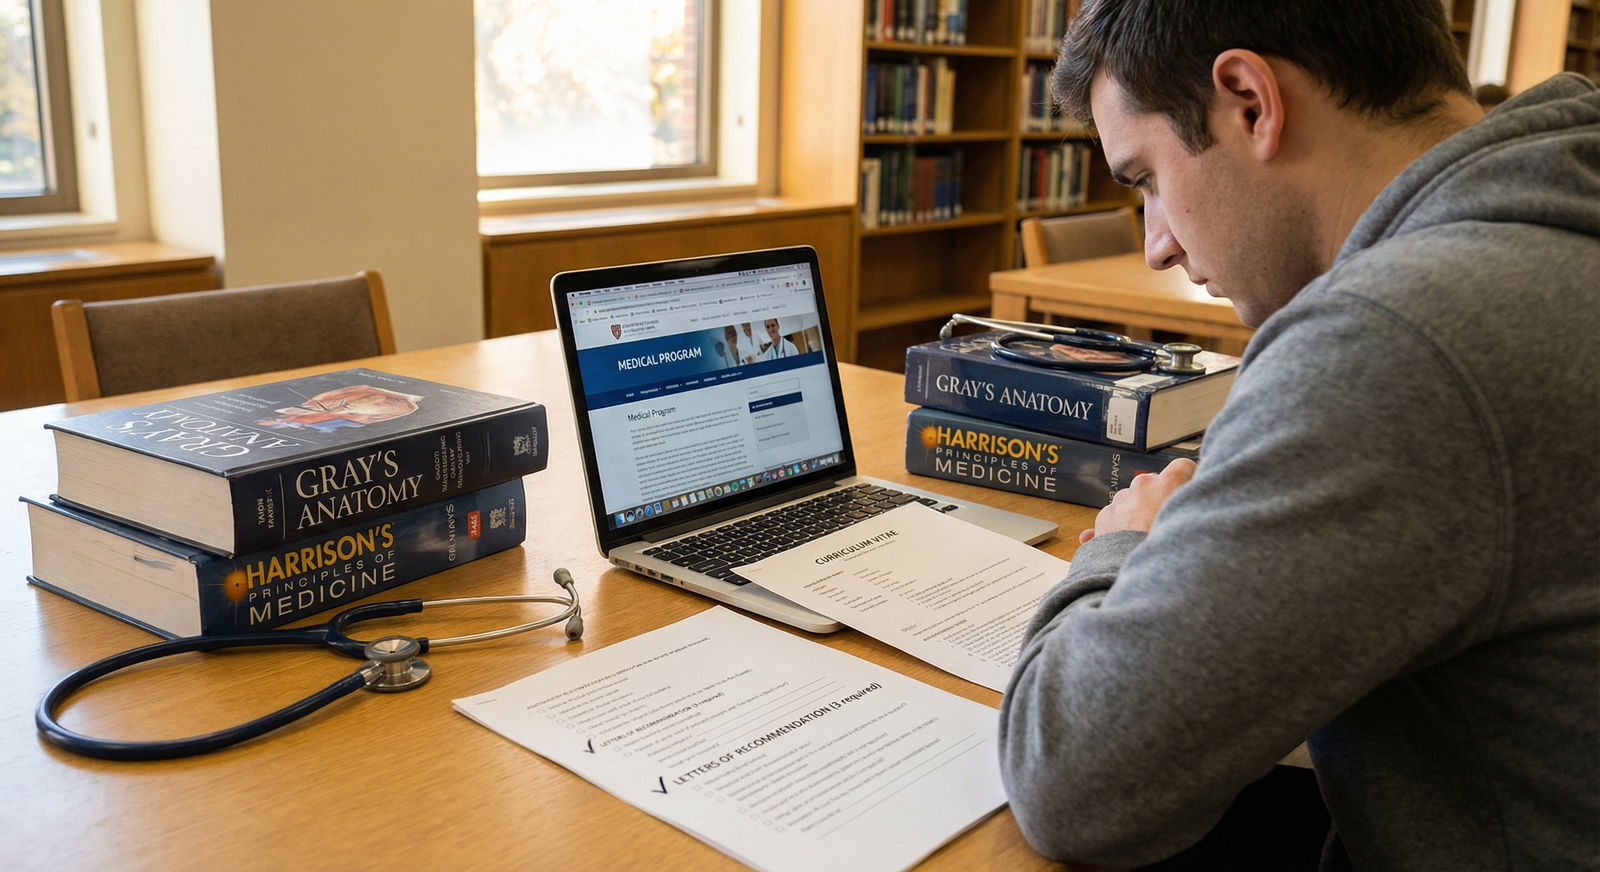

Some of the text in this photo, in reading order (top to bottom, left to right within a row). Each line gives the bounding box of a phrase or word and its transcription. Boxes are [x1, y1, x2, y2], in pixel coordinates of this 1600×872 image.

[617, 346, 702, 372] MEDICAL PROGRAM
[628, 406, 677, 422] Medical Program
[936, 374, 995, 402] GRAY'S
[1000, 388, 1093, 421] ANATOMY
[107, 420, 250, 458] GRAY'S
[133, 409, 301, 449] ANATOMY
[936, 425, 1060, 465] HARRISON'S
[296, 449, 399, 499] GRAY'S
[935, 457, 1056, 492] MEDICINE
[936, 447, 1057, 475] PRINCIPLES OF
[297, 474, 424, 530] ANATOMY
[246, 522, 395, 590] HARRISON'S
[815, 536, 875, 566] CURRICULUM
[872, 529, 900, 547] VITAE
[249, 549, 396, 603] PRINCIPLES OF
[250, 562, 396, 626] MEDICINE
[672, 682, 884, 786] LETTERS OF RECOMMENDATION (3 required)
